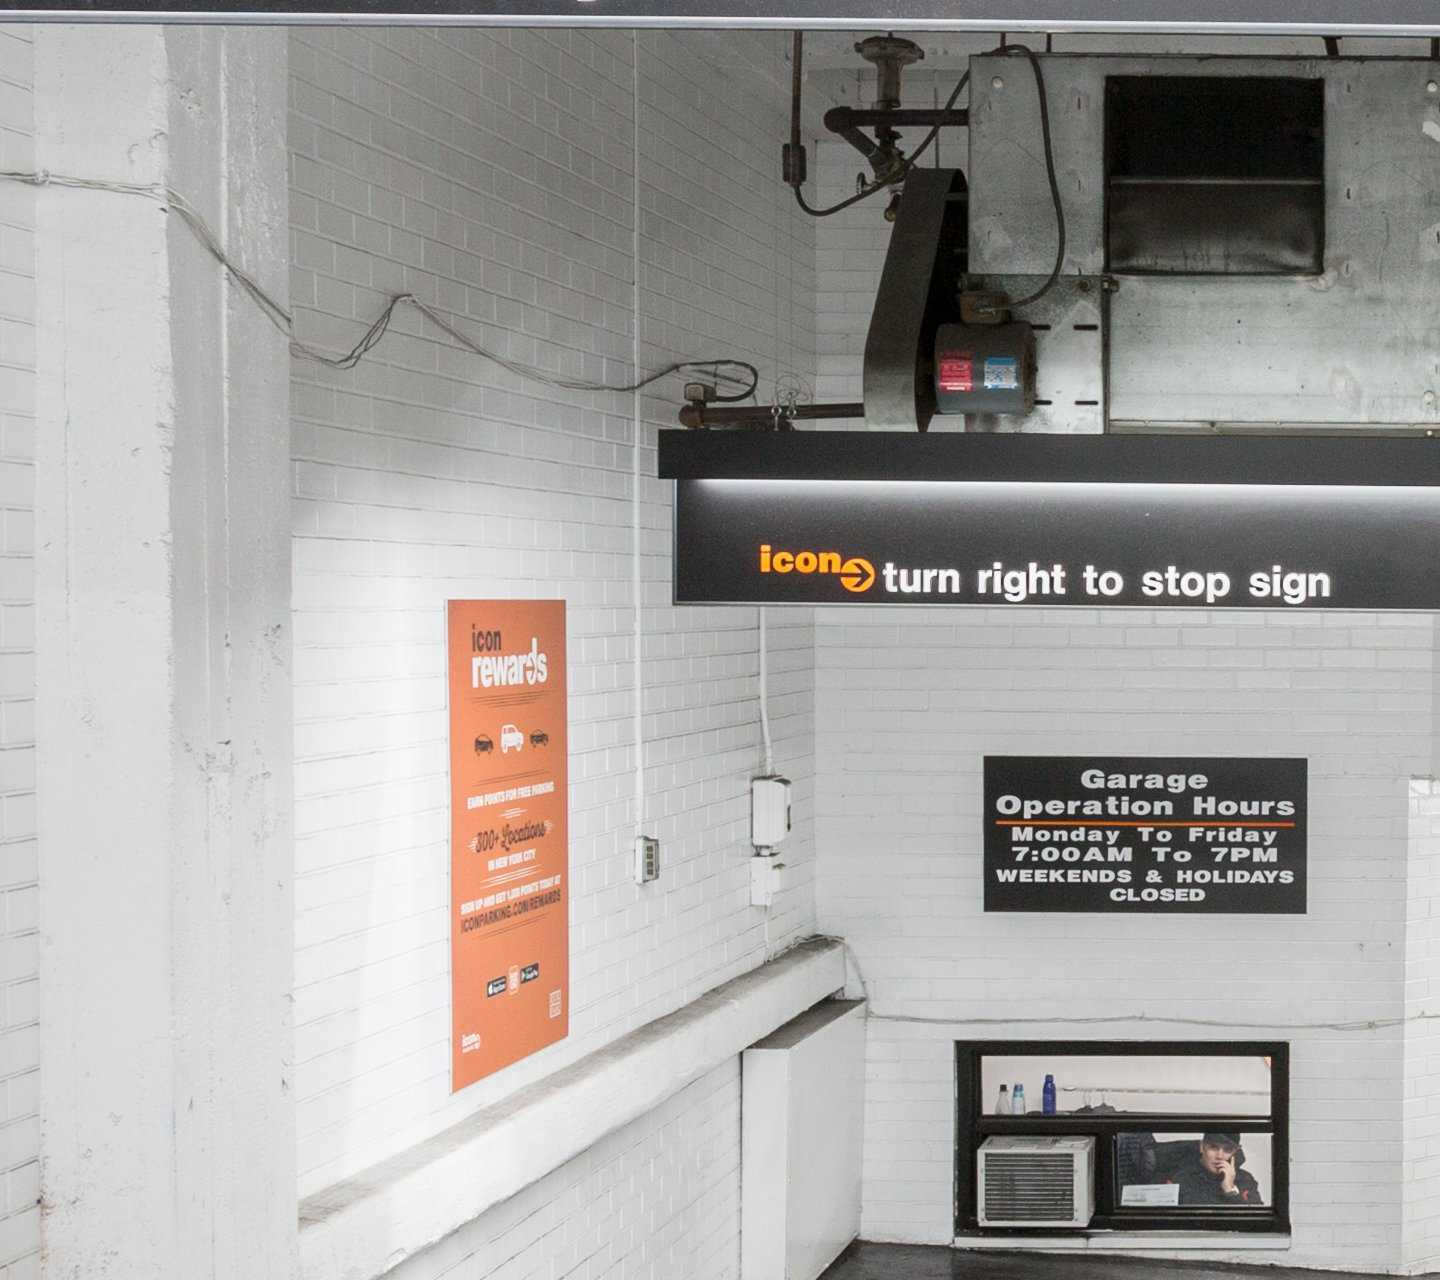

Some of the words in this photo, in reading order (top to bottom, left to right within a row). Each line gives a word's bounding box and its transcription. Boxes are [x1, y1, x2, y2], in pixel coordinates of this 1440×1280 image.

[761, 545, 841, 573] icon
[883, 563, 959, 593] turn
[978, 562, 1065, 602] right
[1083, 566, 1123, 595] to
[1142, 566, 1230, 603] stop
[1249, 565, 1330, 604] sign
[471, 623, 502, 652] icon
[471, 637, 547, 689] rewards
[1081, 770, 1207, 793] Garage
[997, 796, 1172, 819] Operation
[1194, 797, 1294, 815] Hours
[1012, 827, 1119, 844] Monday
[1138, 827, 1172, 841] To
[1189, 828, 1276, 845] Friday
[1013, 847, 1132, 861] 7:00AM
[1152, 848, 1191, 862] To
[1212, 848, 1277, 862] 7PM
[997, 870, 1131, 882] WEEKENDS
[1145, 870, 1163, 883] &
[1177, 870, 1294, 883] HOLIDAYS
[1110, 888, 1205, 901] CLOSED
